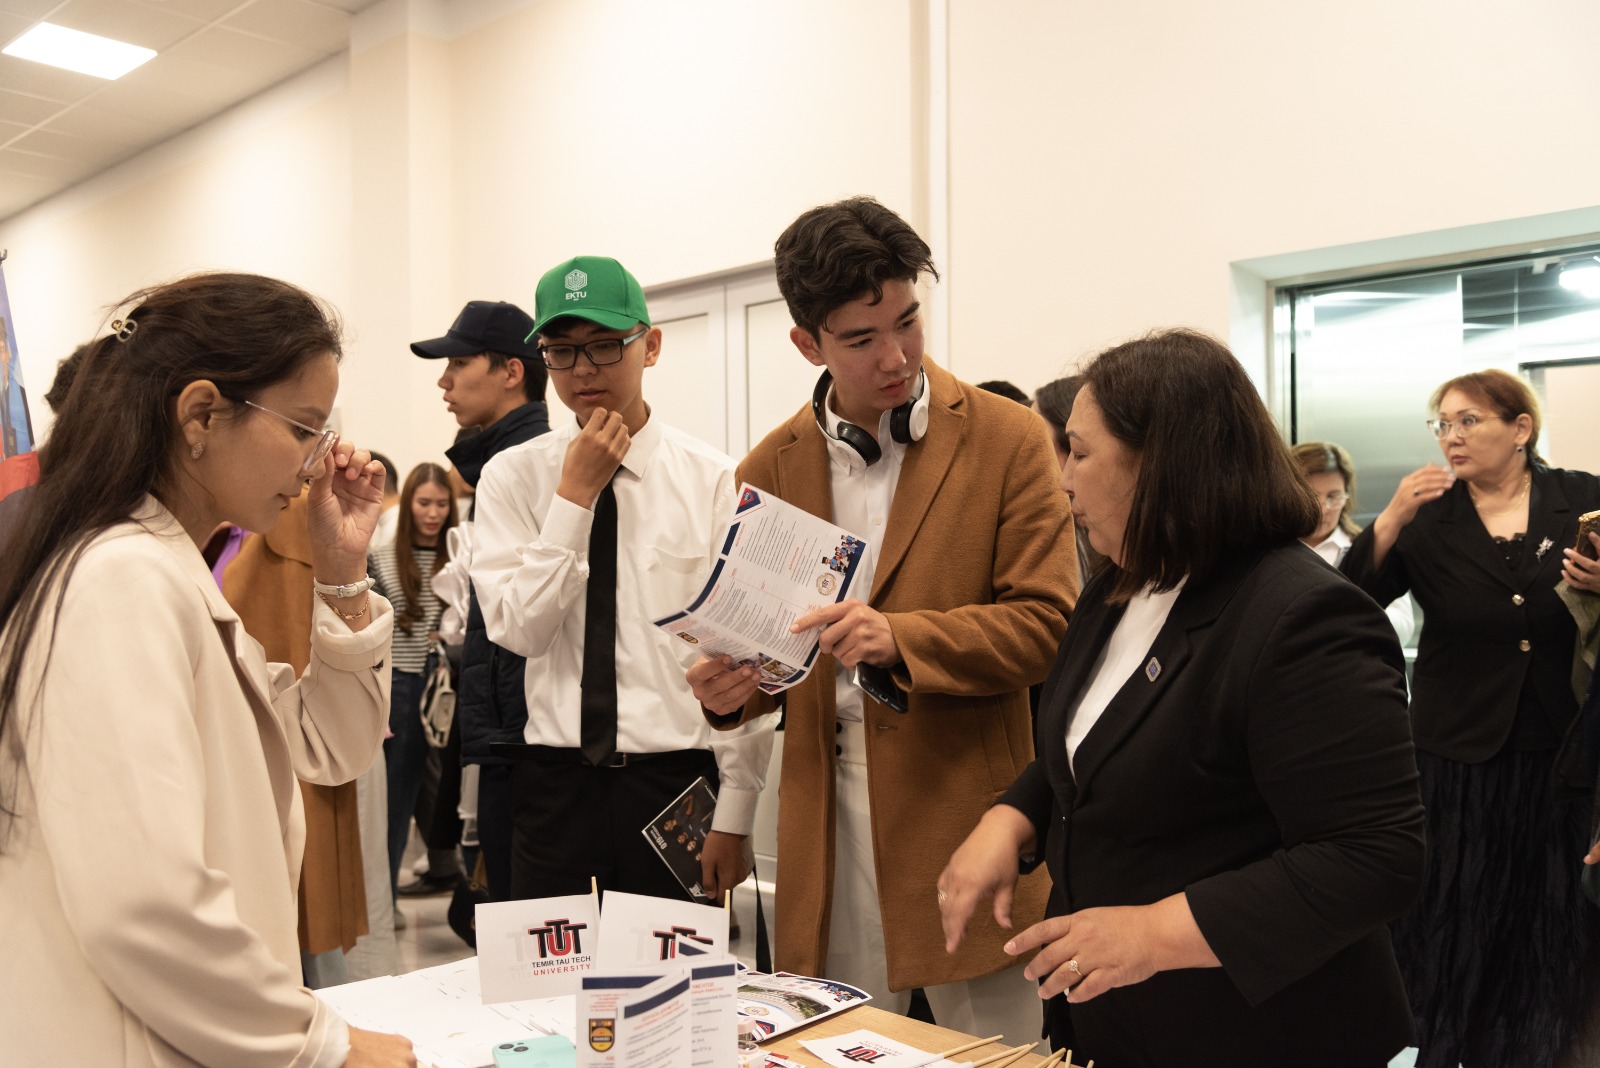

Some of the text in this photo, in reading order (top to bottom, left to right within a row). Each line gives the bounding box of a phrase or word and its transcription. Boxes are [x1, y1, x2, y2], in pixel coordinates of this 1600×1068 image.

[566, 291, 587, 300] EKTU
[532, 960, 555, 968] TEMIR
[571, 955, 591, 963] TECH
[533, 964, 591, 976] UNIVERSITY
